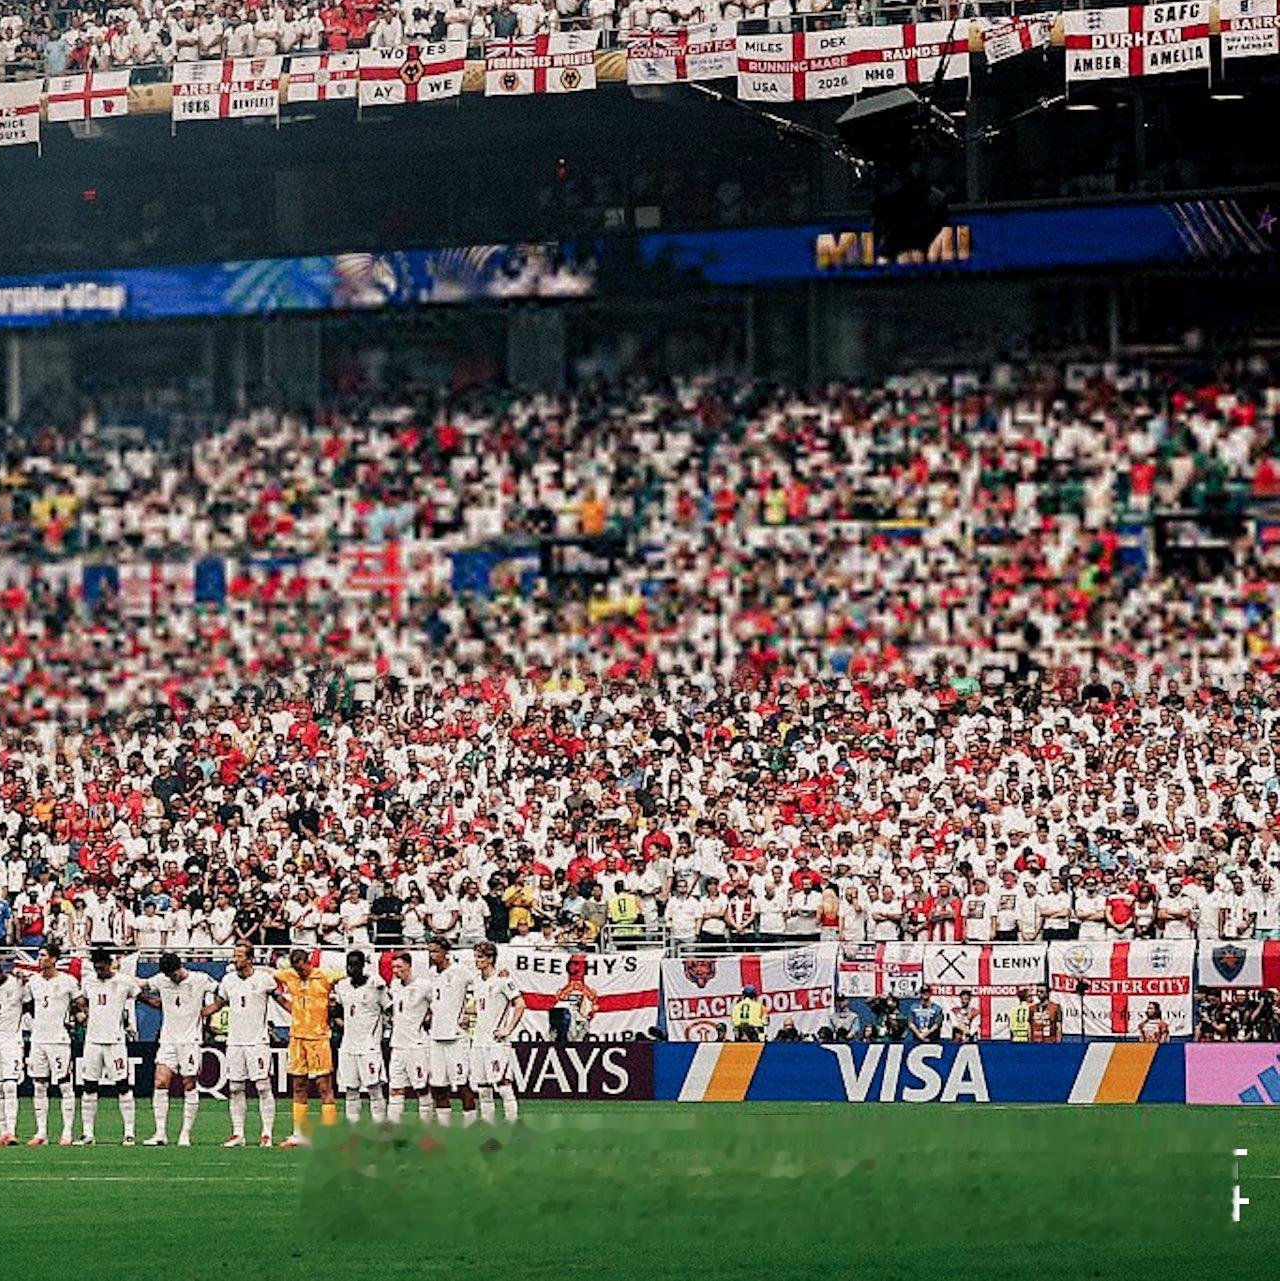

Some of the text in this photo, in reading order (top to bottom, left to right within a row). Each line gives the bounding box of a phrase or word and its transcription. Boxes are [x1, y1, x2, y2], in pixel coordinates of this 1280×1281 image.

[1153, 4, 1200, 23] SAFC
[745, 41, 783, 53] MILES
[820, 36, 846, 49] DEX
[1092, 29, 1182, 48] DURHAM
[380, 43, 447, 60] WOVES
[1150, 45, 1204, 67] AMELIA
[748, 60, 808, 73] RUNNING
[1073, 57, 1121, 72] AMBER
[179, 79, 273, 96] ARSENAL FC
[374, 79, 453, 99] AY WE
[752, 82, 778, 94] USA
[516, 954, 638, 975] BEECHY'S
[993, 957, 1041, 969] LENNY
[1146, 977, 1190, 992] CITY
[669, 988, 833, 1020] BLACKOOL FC
[822, 1043, 991, 1103] VISA
